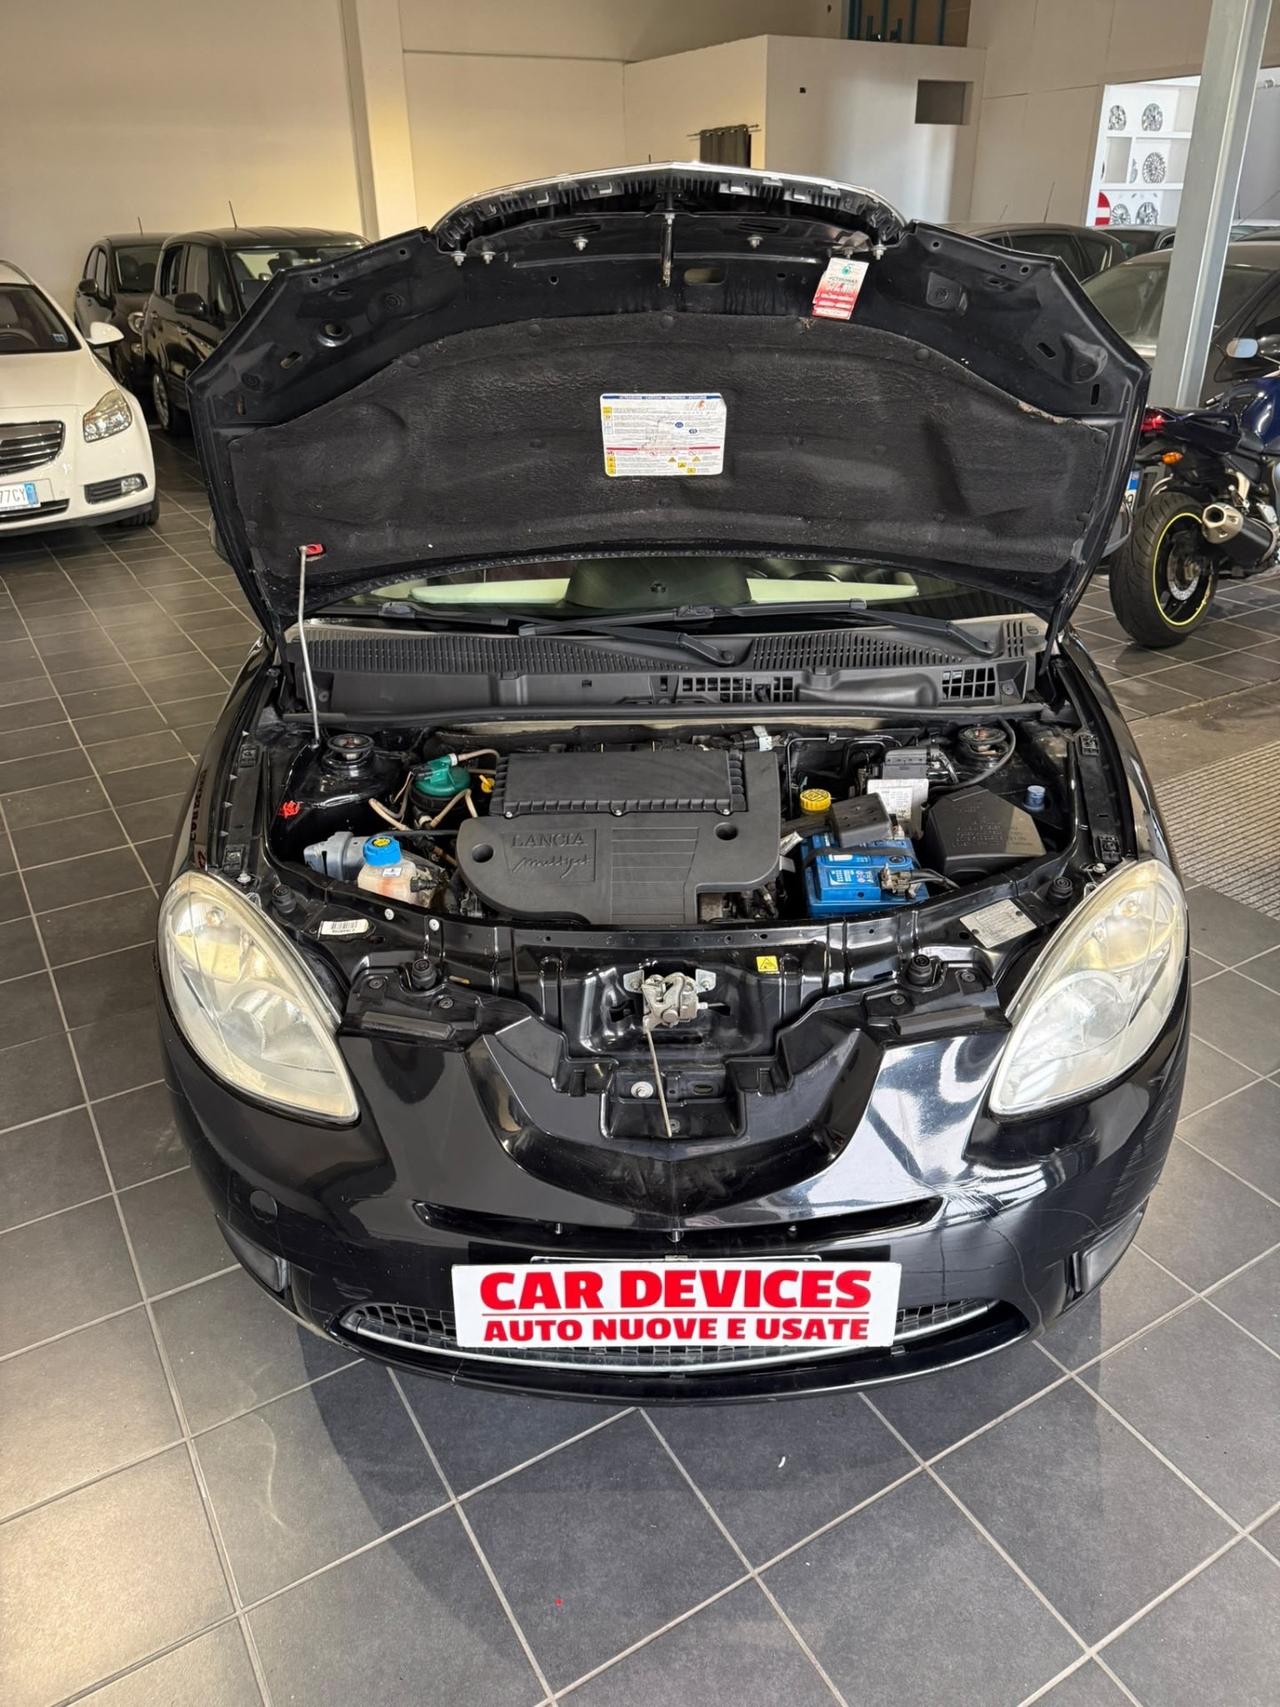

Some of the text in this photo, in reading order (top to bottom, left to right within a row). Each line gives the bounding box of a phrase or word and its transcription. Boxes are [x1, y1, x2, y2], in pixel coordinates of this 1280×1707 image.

[511, 831, 588, 848] LANCIA
[480, 1270, 870, 1310] CAR DEVICES
[484, 1318, 867, 1341] AUTO NUOVE E USATE
